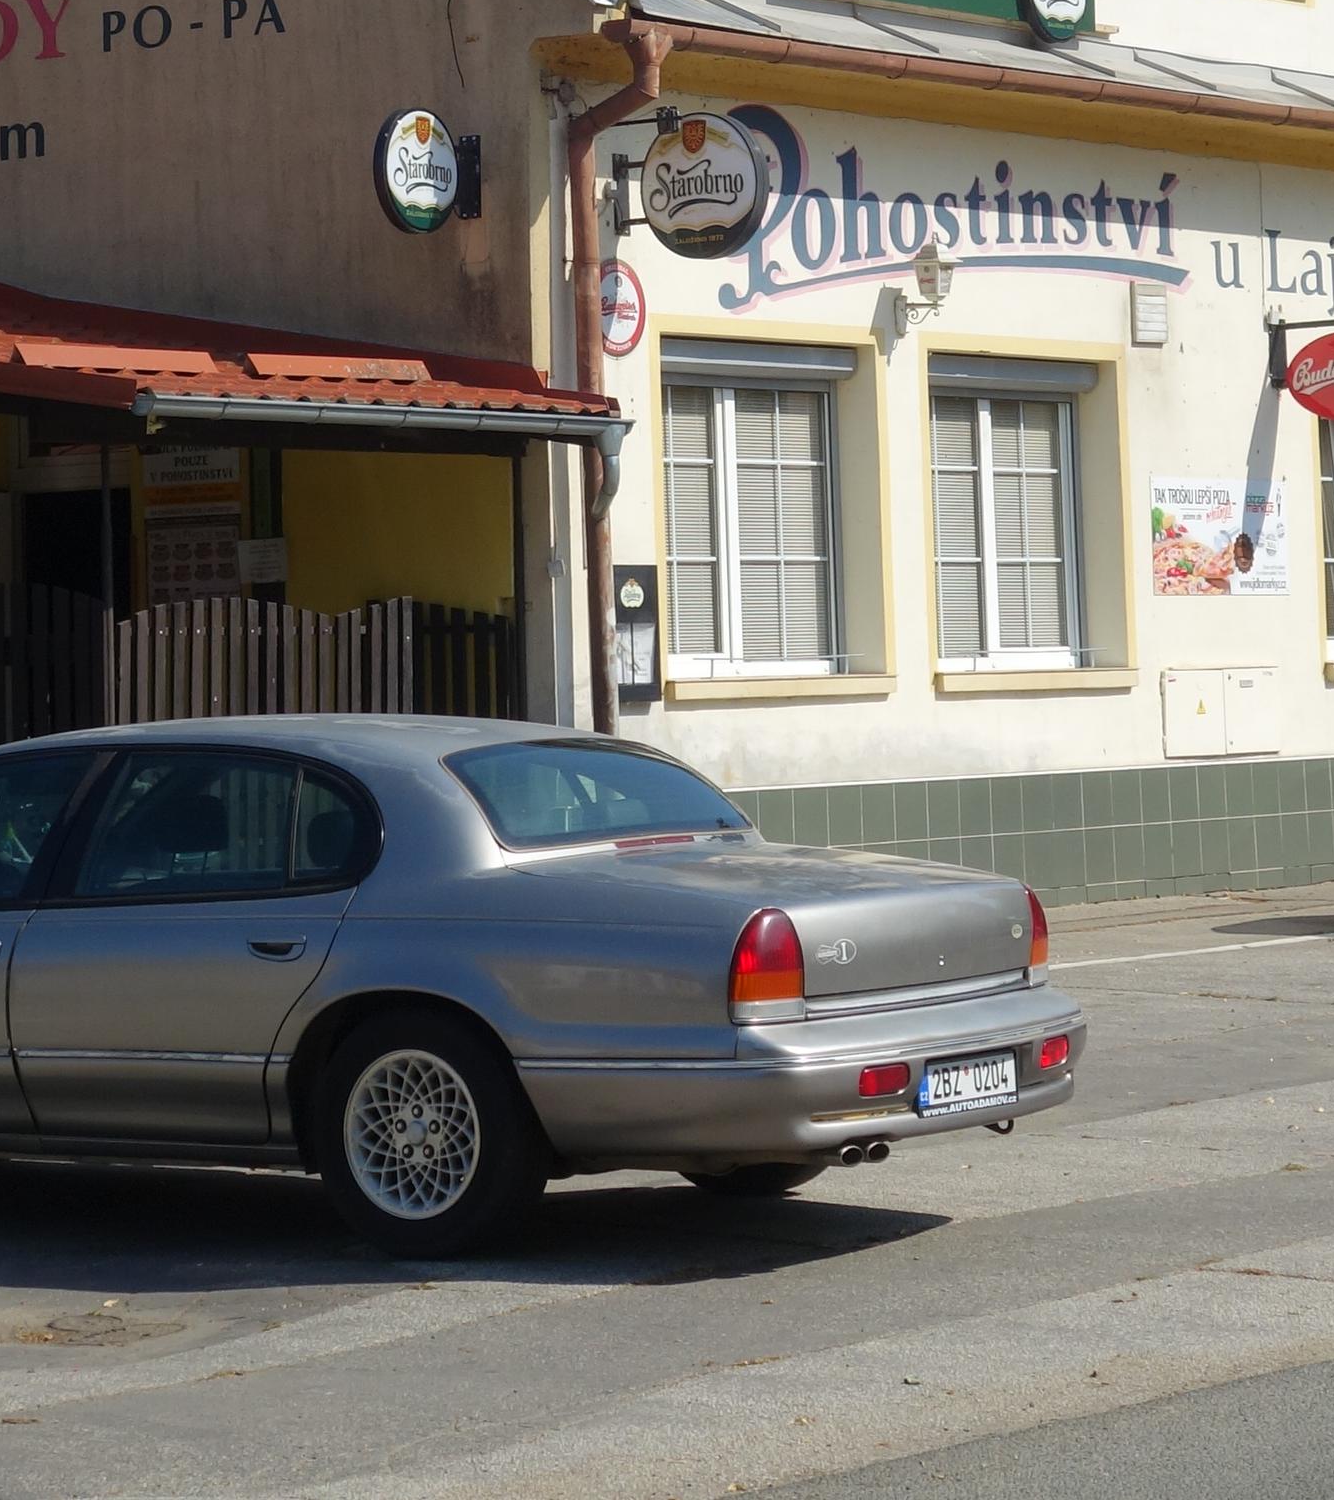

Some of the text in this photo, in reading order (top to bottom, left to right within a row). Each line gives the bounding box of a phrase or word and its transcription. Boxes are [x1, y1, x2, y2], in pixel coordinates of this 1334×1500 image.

[102, 4, 172, 53] PO
[394, 146, 453, 194] Starobrno
[650, 158, 744, 219] Starobrno
[718, 104, 1189, 313] Pohostinství
[1210, 240, 1245, 289] u
[174, 454, 209, 468] POUZE
[1153, 484, 1230, 506] TAK TROŠKU LEPŠÍ PIZZA
[932, 1058, 1009, 1100] 2BZ 0204
[923, 1094, 1017, 1118] www.AUTOADAMOV.cz
